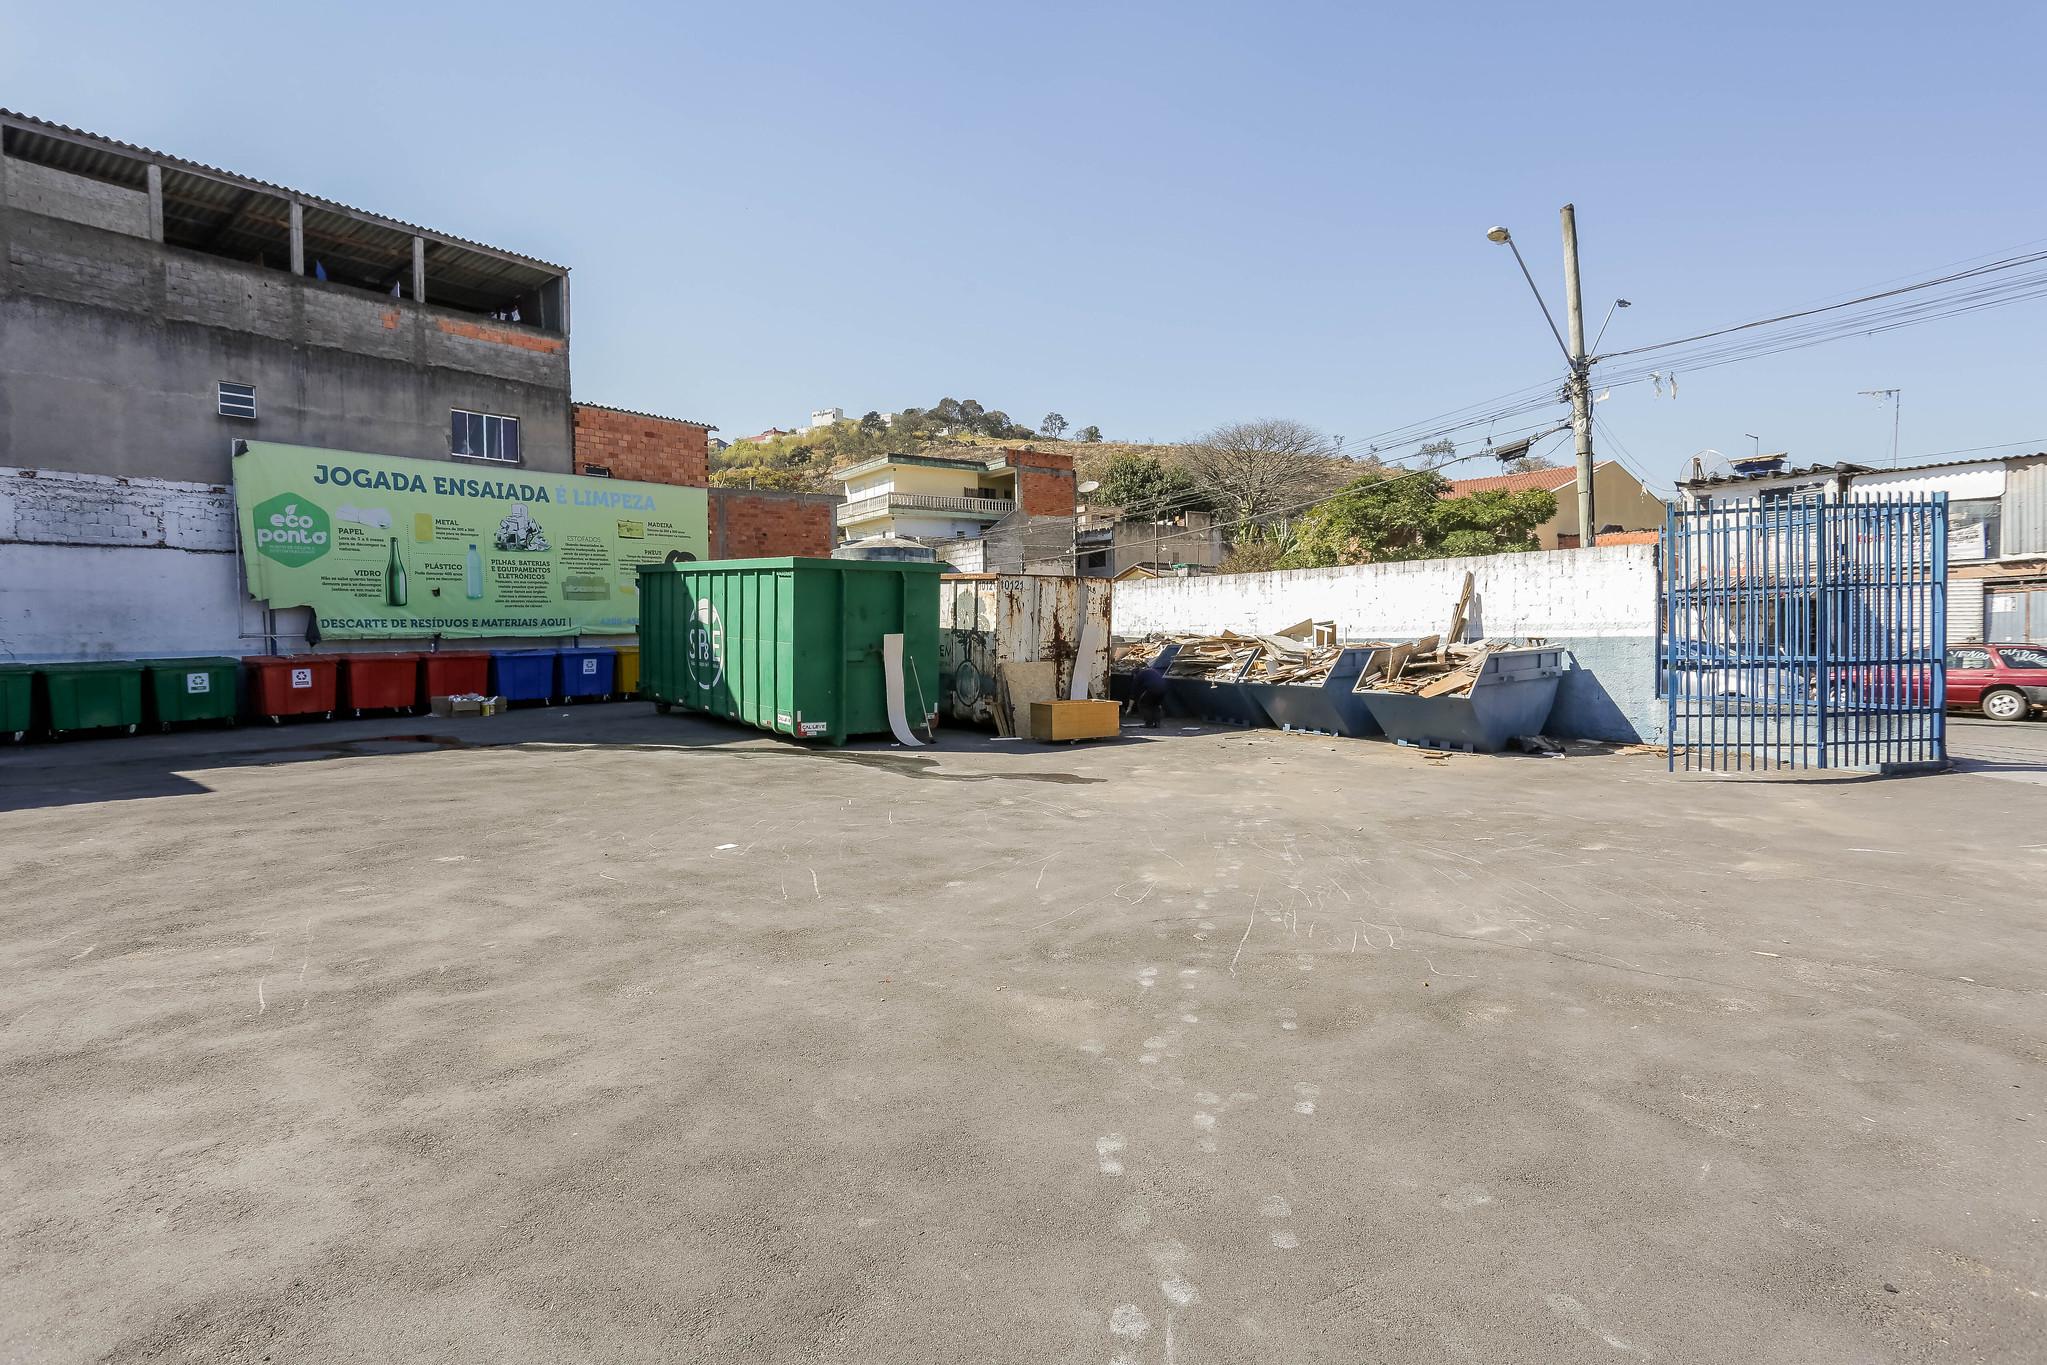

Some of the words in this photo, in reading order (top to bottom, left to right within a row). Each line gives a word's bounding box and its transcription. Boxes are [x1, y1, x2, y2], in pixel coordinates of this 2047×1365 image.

[313, 465, 427, 494] JOGADA
[433, 476, 550, 503] ENSAIADA
[555, 484, 568, 505] É
[572, 489, 656, 511] LIMPEZA
[270, 514, 313, 528] eco
[338, 527, 364, 535] PAPEL
[257, 529, 327, 547] ponto
[424, 562, 462, 570] PLÁSTICO
[1001, 580, 1024, 590] 10121
[321, 618, 388, 629] DESCARTE
[391, 618, 407, 628] DE
[410, 617, 469, 628] RESÍDUOS
[472, 619, 478, 628] E
[481, 618, 538, 627] MATERIAIS
[540, 618, 566, 628] AQUI
[1949, 650, 1991, 660] VENDO
